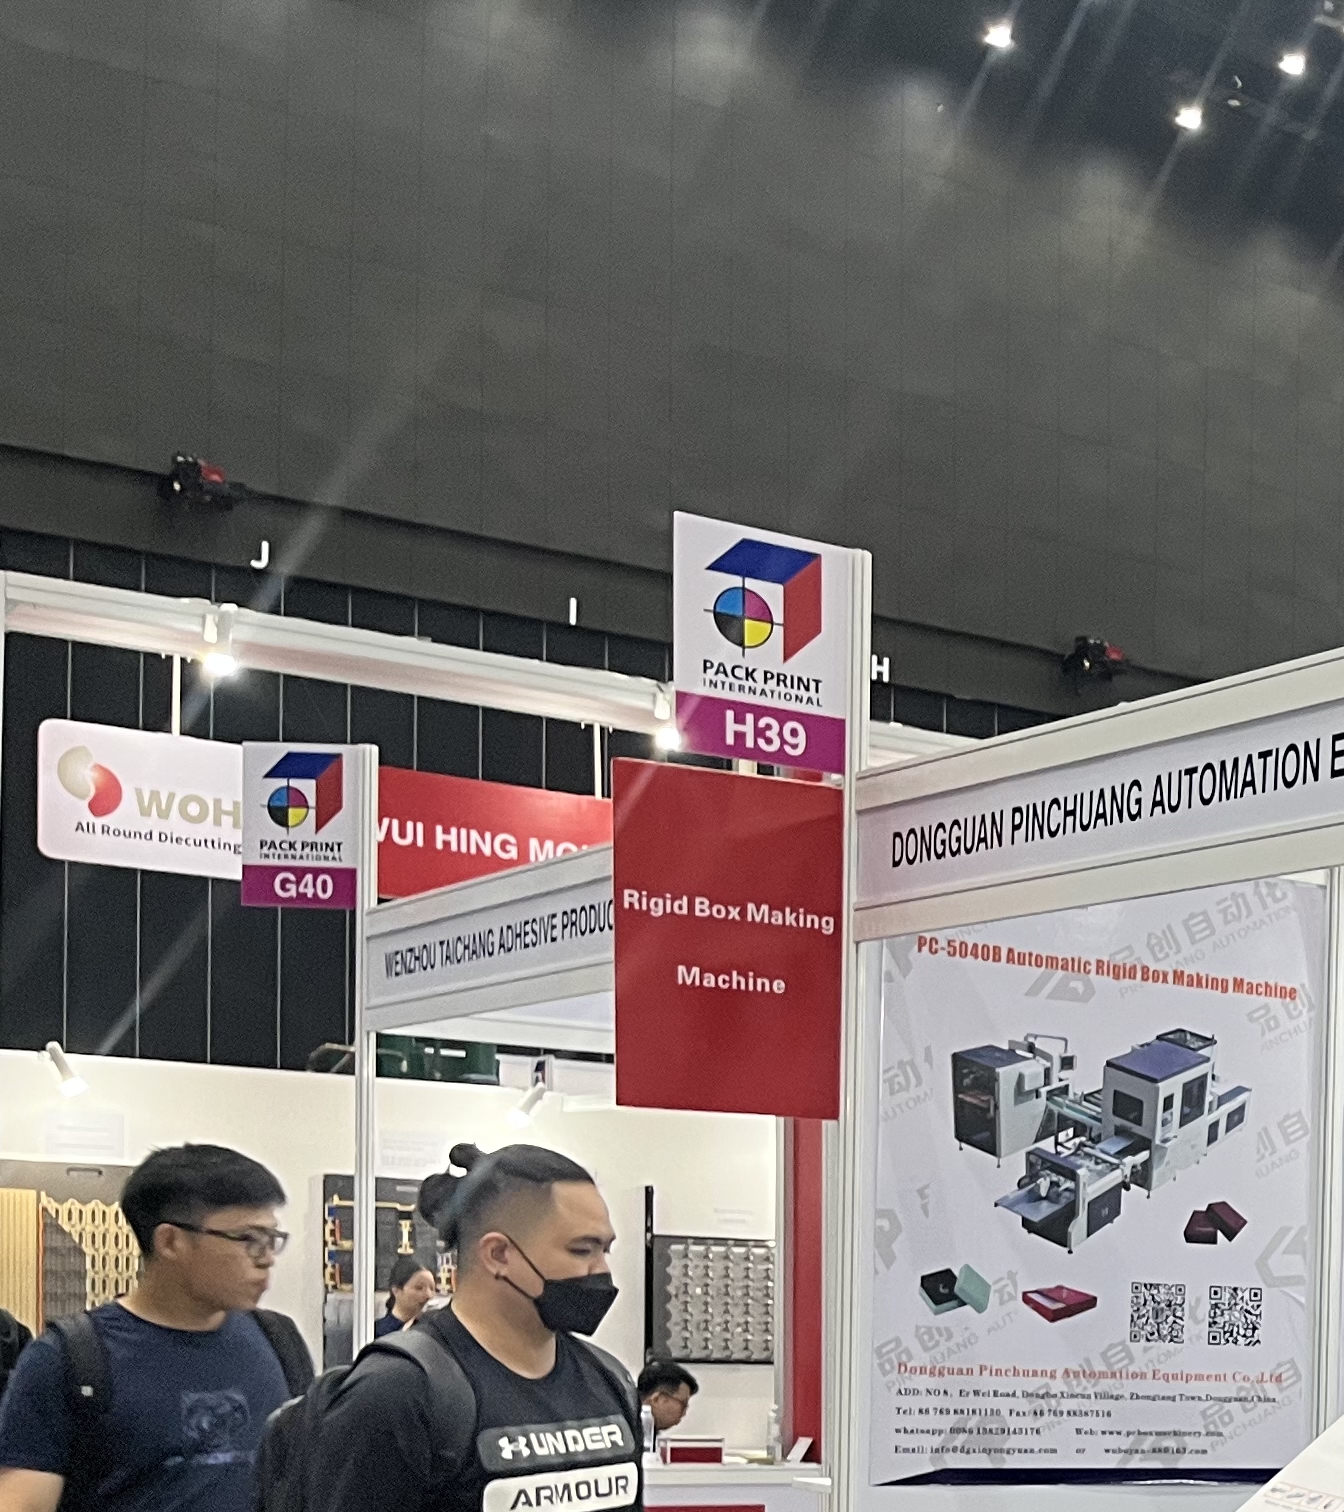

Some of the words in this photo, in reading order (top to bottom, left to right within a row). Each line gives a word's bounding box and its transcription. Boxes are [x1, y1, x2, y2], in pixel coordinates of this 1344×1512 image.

[251, 540, 270, 570] J
[702, 659, 757, 684] PACK
[763, 669, 823, 694] PRINT
[702, 677, 823, 708] INTERNATIONAL
[725, 709, 807, 756] H39
[892, 809, 1004, 868] DONGGUAN
[1010, 779, 1142, 845] PINCHUANG
[1150, 738, 1321, 818] AUTOMATION
[74, 822, 94, 838] All
[101, 824, 152, 842] Round
[158, 832, 242, 855] Diecutting
[260, 839, 297, 852] PACK
[301, 841, 343, 853] PRINT
[435, 824, 518, 861] HING
[260, 852, 342, 862] INTERNATIONAL
[274, 872, 333, 900] G40
[623, 888, 688, 917] Rigid
[695, 897, 741, 921] Box
[747, 902, 834, 935] Making
[385, 945, 437, 979] WENZHOU
[439, 930, 495, 969] TAICHANG
[498, 913, 557, 956] ADHESIVE
[677, 965, 786, 994] Machine
[917, 935, 1002, 963] PC-5040B
[1006, 948, 1092, 975] Automatic
[1096, 958, 1137, 981] Rigid
[1141, 965, 1169, 984] Box
[1173, 969, 1229, 994] Making
[1232, 976, 1297, 1001] Machine
[897, 1361, 974, 1378] Dongguan
[979, 1364, 1057, 1380] Pinchuang
[1062, 1367, 1147, 1381] Automation
[1151, 1369, 1228, 1384] Equipment
[529, 1424, 624, 1456] UNDER
[509, 1475, 629, 1511] ARMOUR
